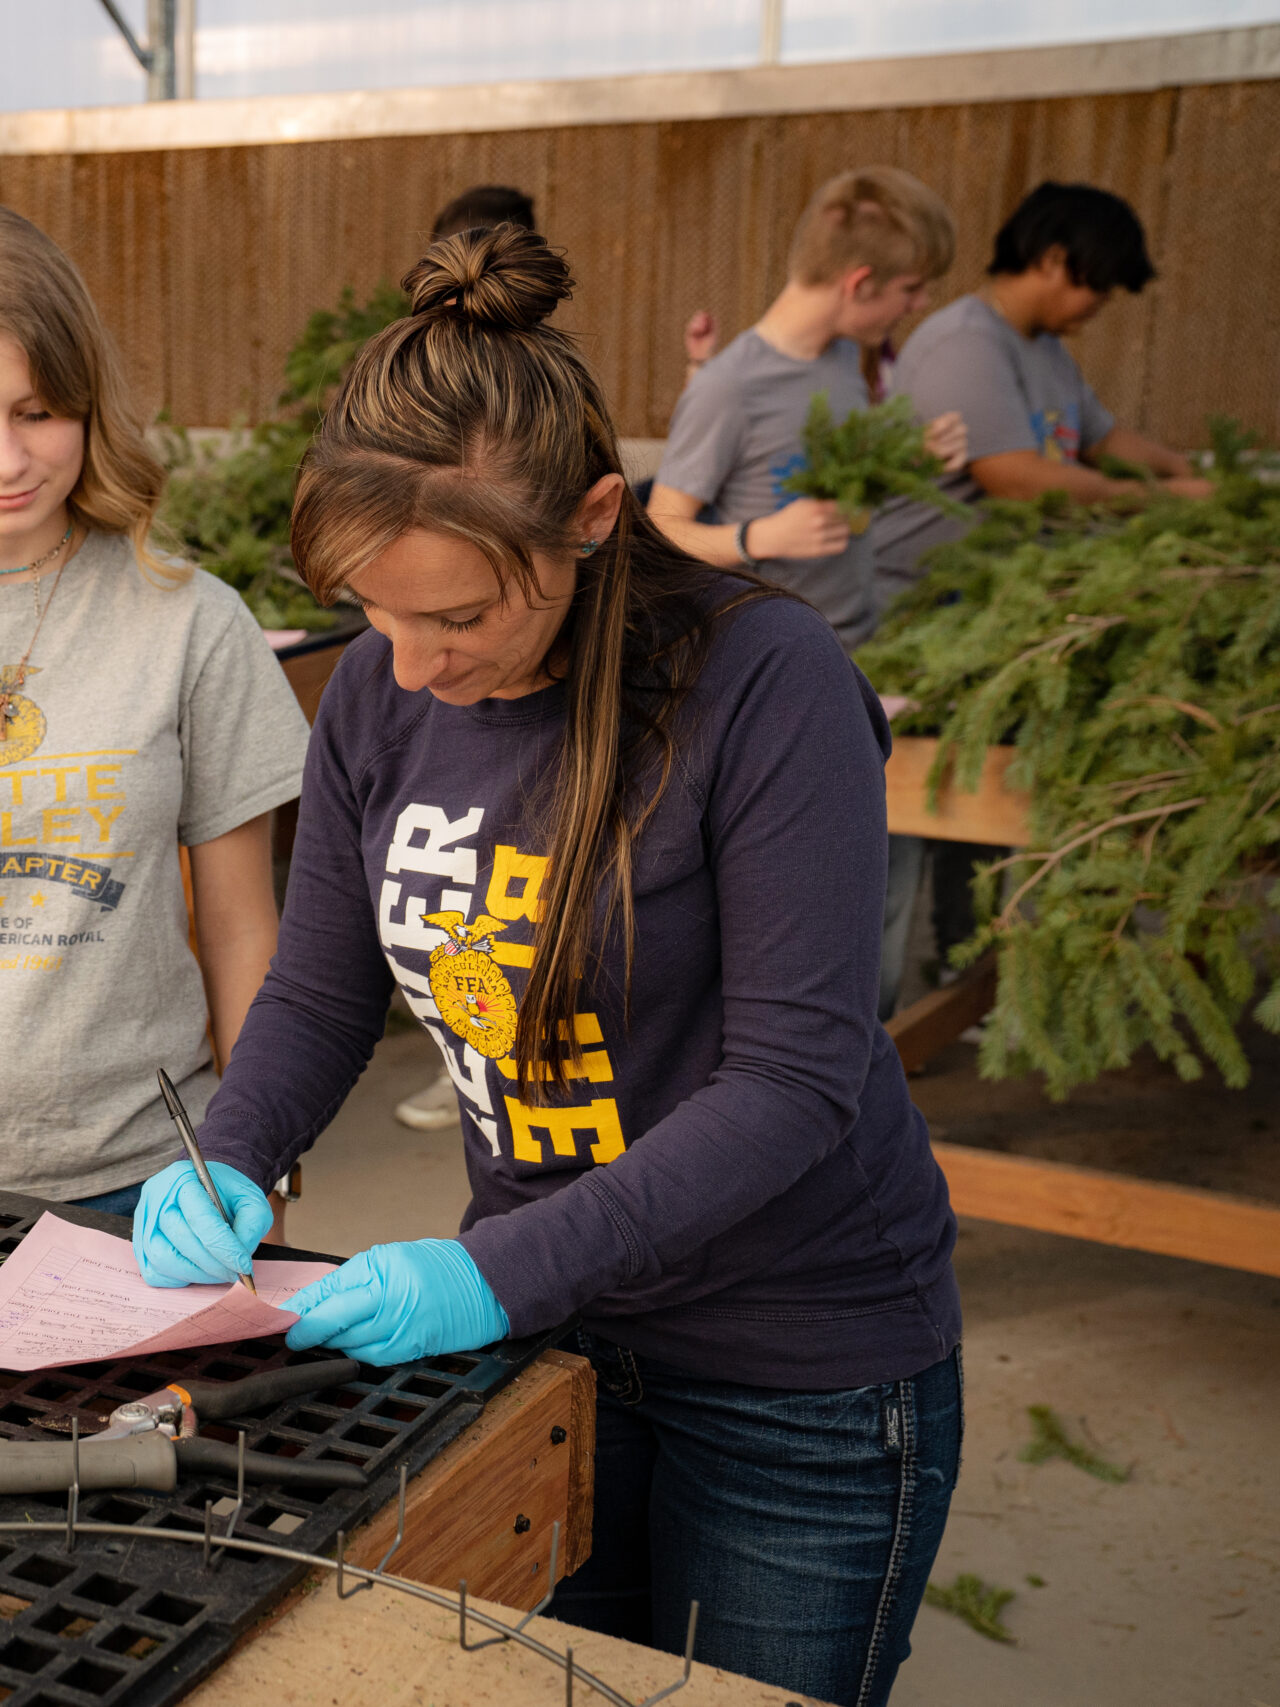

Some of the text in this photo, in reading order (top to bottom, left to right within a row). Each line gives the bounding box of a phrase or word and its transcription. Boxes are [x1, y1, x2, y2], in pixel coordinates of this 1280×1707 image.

[14, 917, 34, 930] OF
[57, 930, 105, 947] ROYAL
[453, 975, 490, 996] FFA
